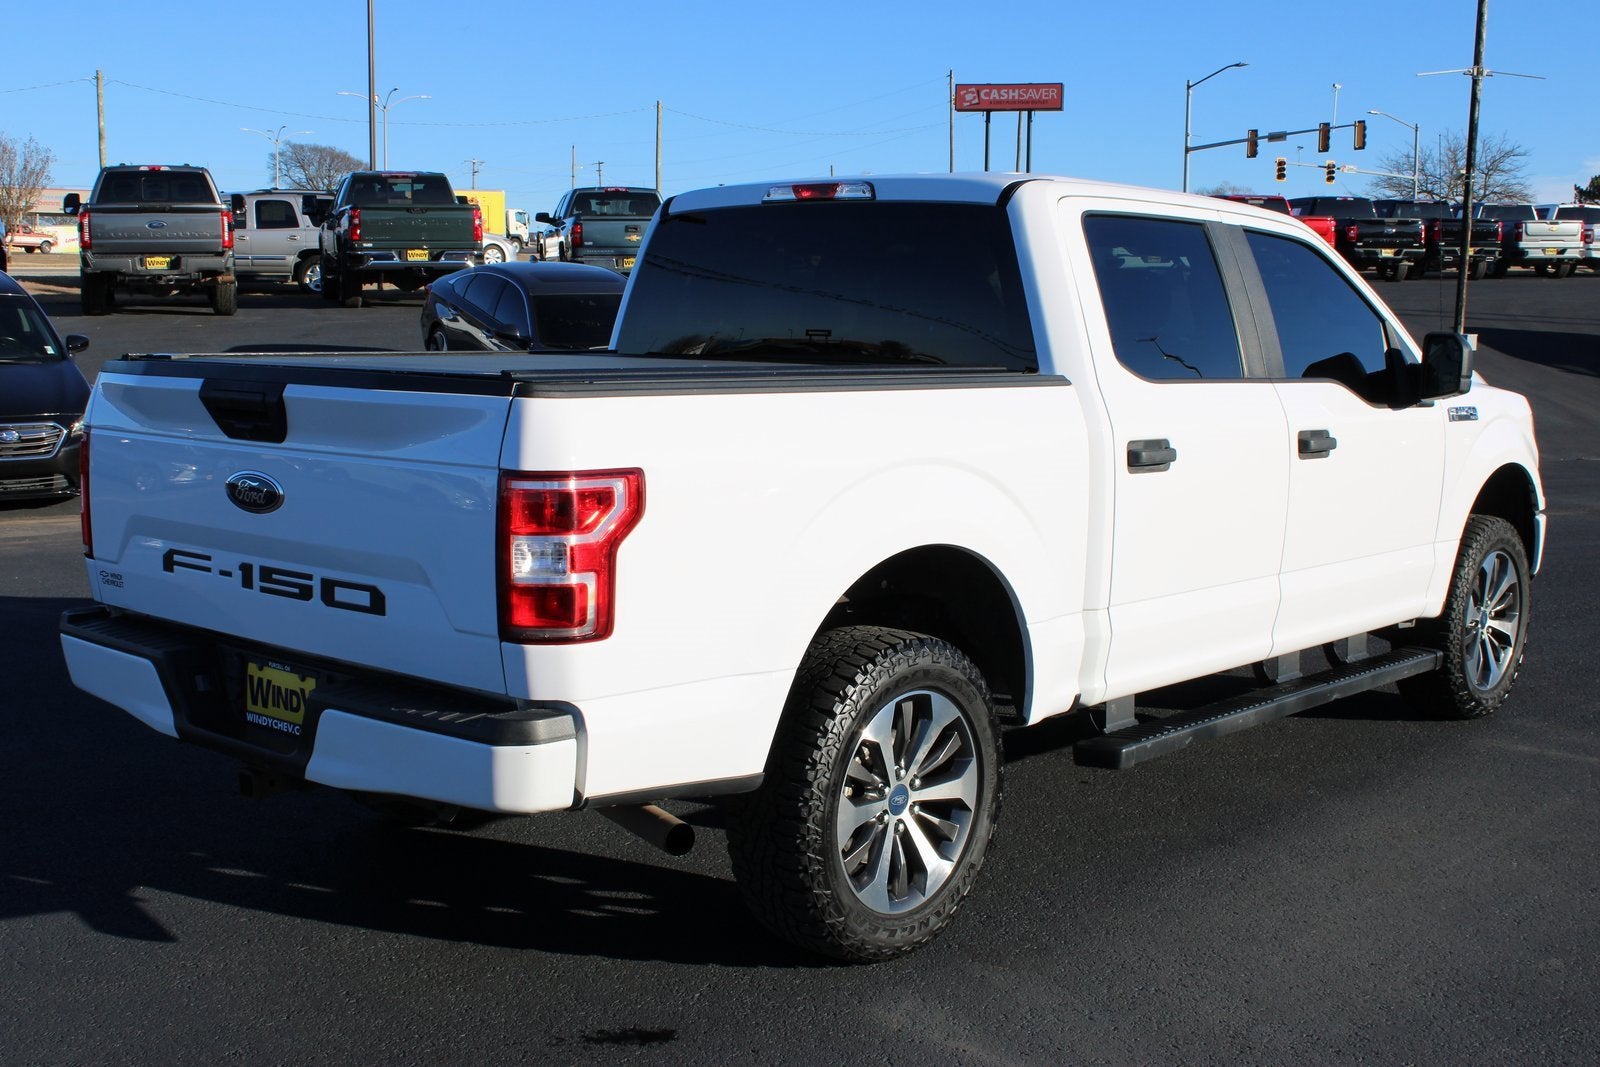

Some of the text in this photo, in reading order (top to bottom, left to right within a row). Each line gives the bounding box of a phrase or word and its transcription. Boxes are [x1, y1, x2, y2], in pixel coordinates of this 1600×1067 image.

[980, 88, 1057, 100] CASHSAVER
[235, 479, 267, 504] Ford
[163, 548, 386, 617] F-150
[246, 711, 301, 735] WINDYCHEV.C
